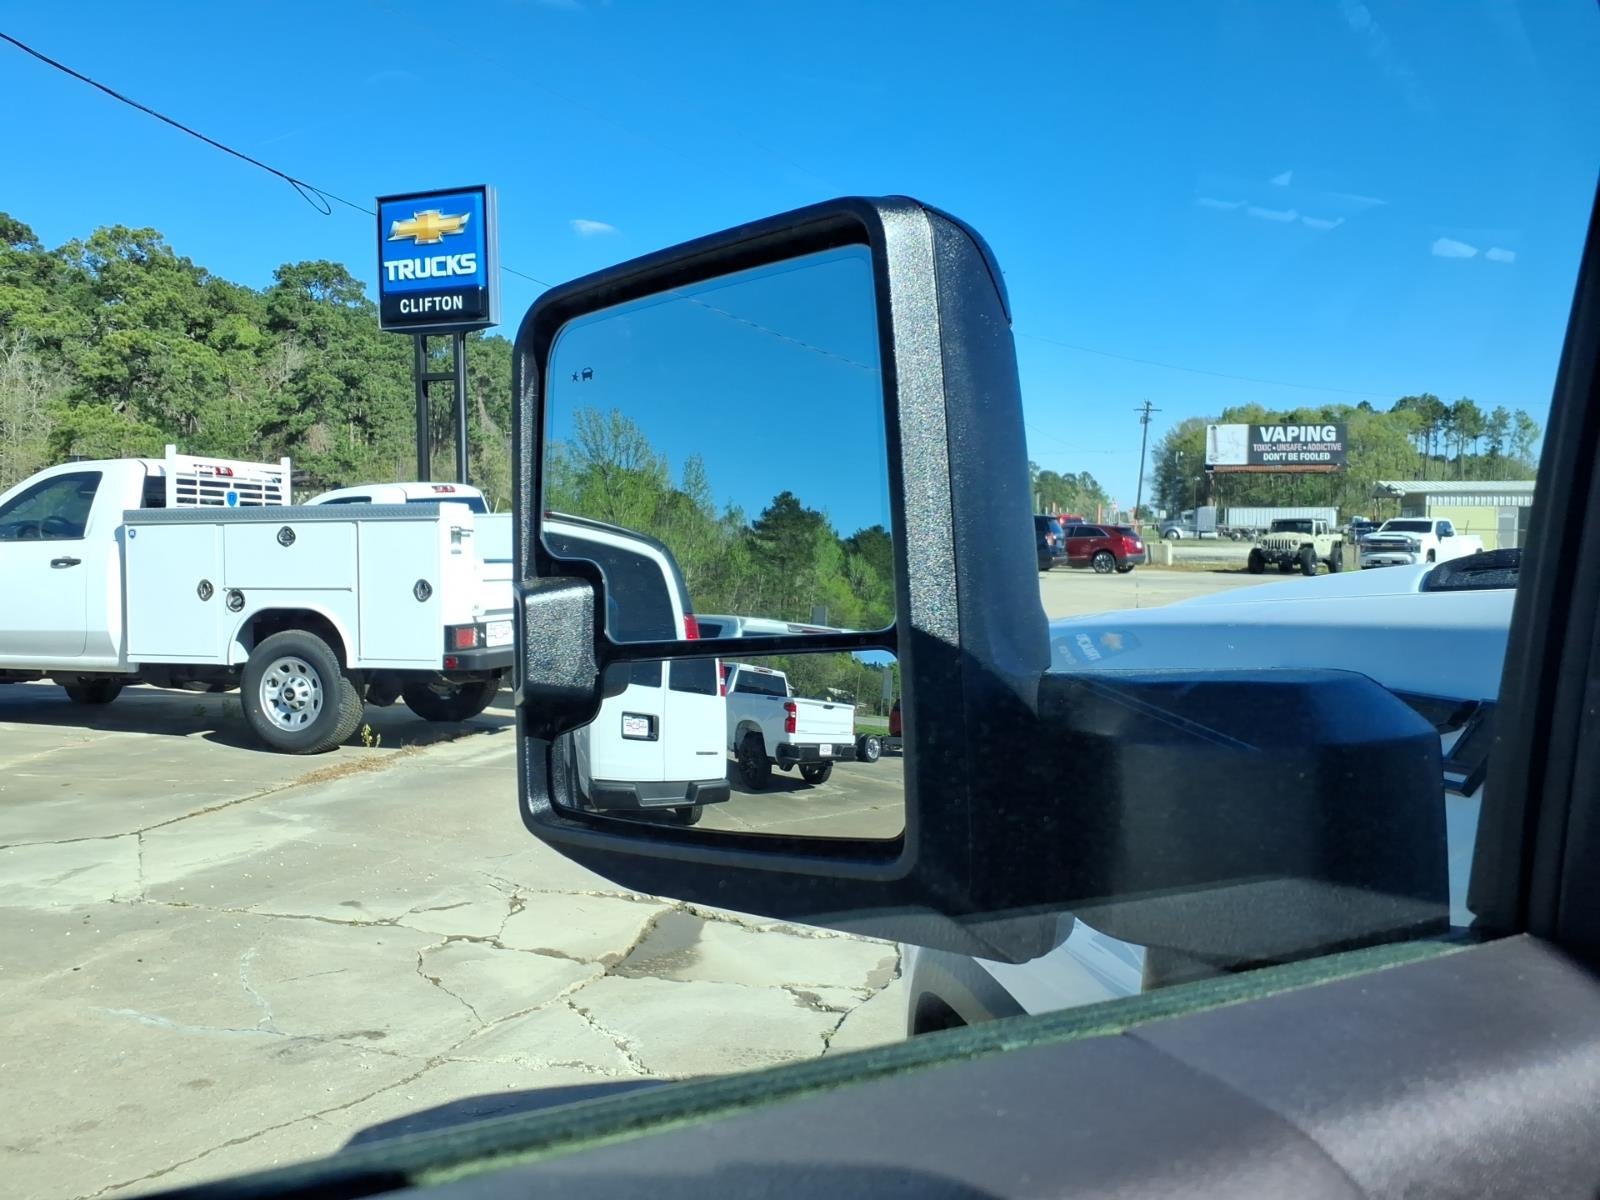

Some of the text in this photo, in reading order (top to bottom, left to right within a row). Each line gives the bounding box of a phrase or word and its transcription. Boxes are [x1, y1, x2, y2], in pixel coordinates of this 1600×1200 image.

[384, 253, 477, 281] TRUCKS
[400, 295, 463, 314] CLIFTON
[1260, 425, 1336, 442] VAPING
[1253, 443, 1342, 452] TOXIC UNSAFE ADDICTIVE
[1263, 452, 1330, 461] DON'T BE FOOLED
